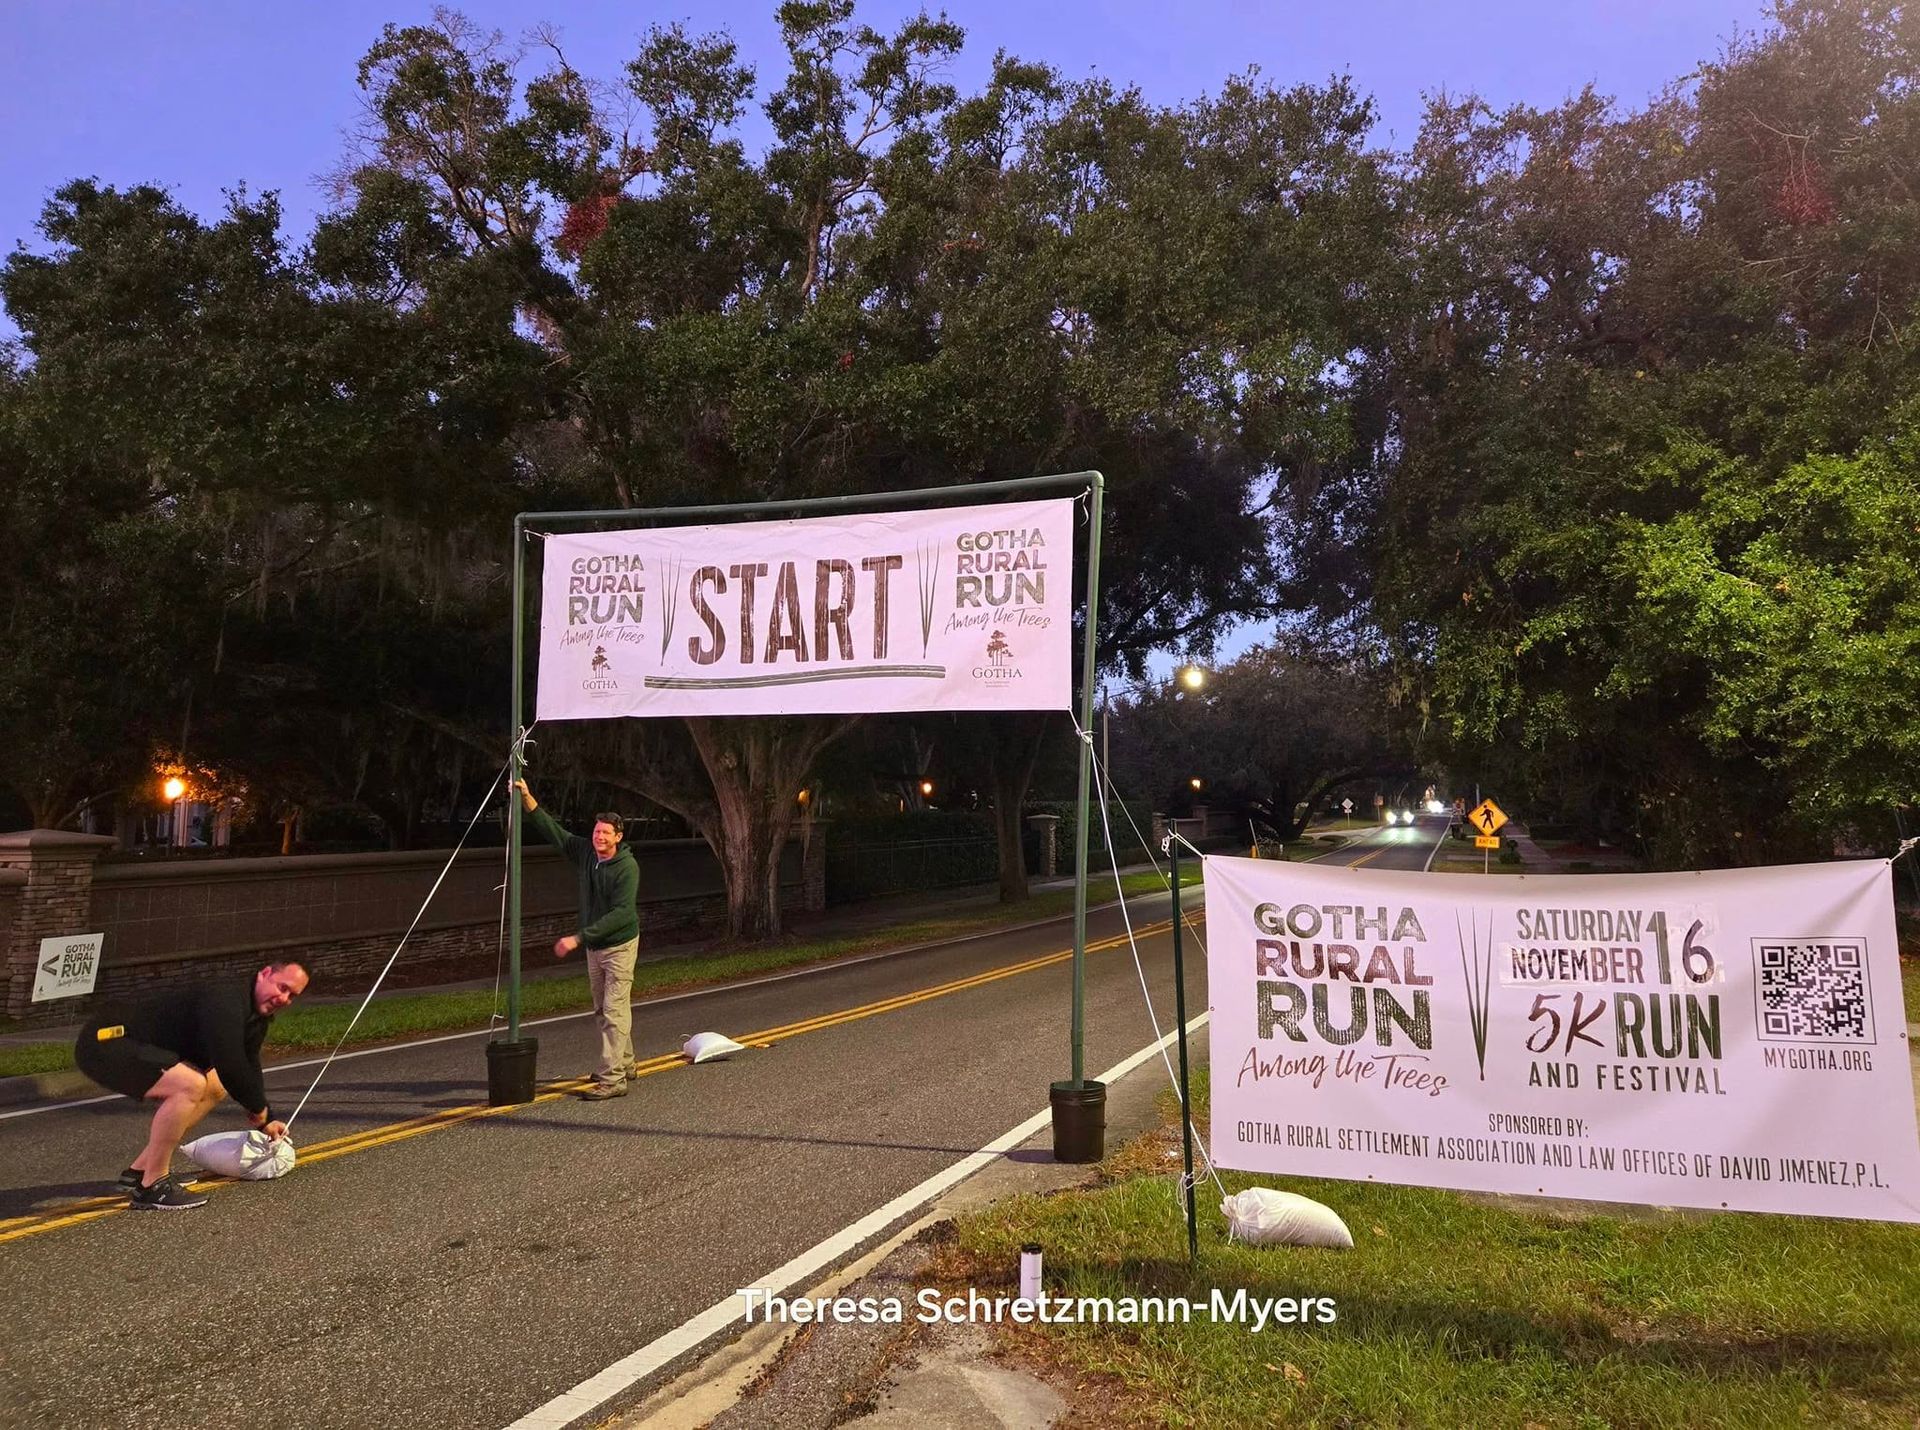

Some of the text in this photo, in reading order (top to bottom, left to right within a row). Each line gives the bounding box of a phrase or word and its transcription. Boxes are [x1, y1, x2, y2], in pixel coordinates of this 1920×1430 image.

[956, 528, 1046, 552] GOTHA
[571, 554, 644, 575] GOTHA
[957, 549, 1047, 574] RURAL
[569, 574, 646, 595] RURAL
[956, 571, 1045, 608] RUN
[568, 594, 643, 625] RUN
[688, 555, 903, 665] START
[944, 607, 1051, 635] Among the Trees
[560, 625, 646, 650] Among the Trees
[1253, 902, 1427, 942] GOTHA
[1516, 908, 1642, 943] SATURDAY
[63, 952, 94, 963] RURAL
[65, 943, 95, 953] GOTHA
[1256, 939, 1434, 986] RURAL
[1646, 911, 1715, 985] 16
[61, 961, 93, 978] RUN
[1511, 947, 1645, 984] NOVEMBER
[1256, 980, 1433, 1050] RUN
[1525, 991, 1722, 1060] 5K RUN
[1237, 1046, 1450, 1097] Among the Trees
[1764, 1047, 1873, 1071] MYGOTHA.ORG
[1529, 1061, 1727, 1095] AND FESTIVAL
[1489, 1113, 1589, 1138] SPONSORED BY:
[1237, 1120, 1282, 1146] GOTHA
[1287, 1124, 1332, 1149] RURAL
[1338, 1128, 1430, 1158] SETTLEMENT
[1437, 1136, 1537, 1166] ASSOCIATION
[1542, 1144, 1572, 1168] AND
[1579, 1145, 1615, 1171] LAW
[1623, 1148, 1688, 1177] OFFICES
[1694, 1154, 1713, 1178] OF
[1720, 1155, 1771, 1182] DAVID
